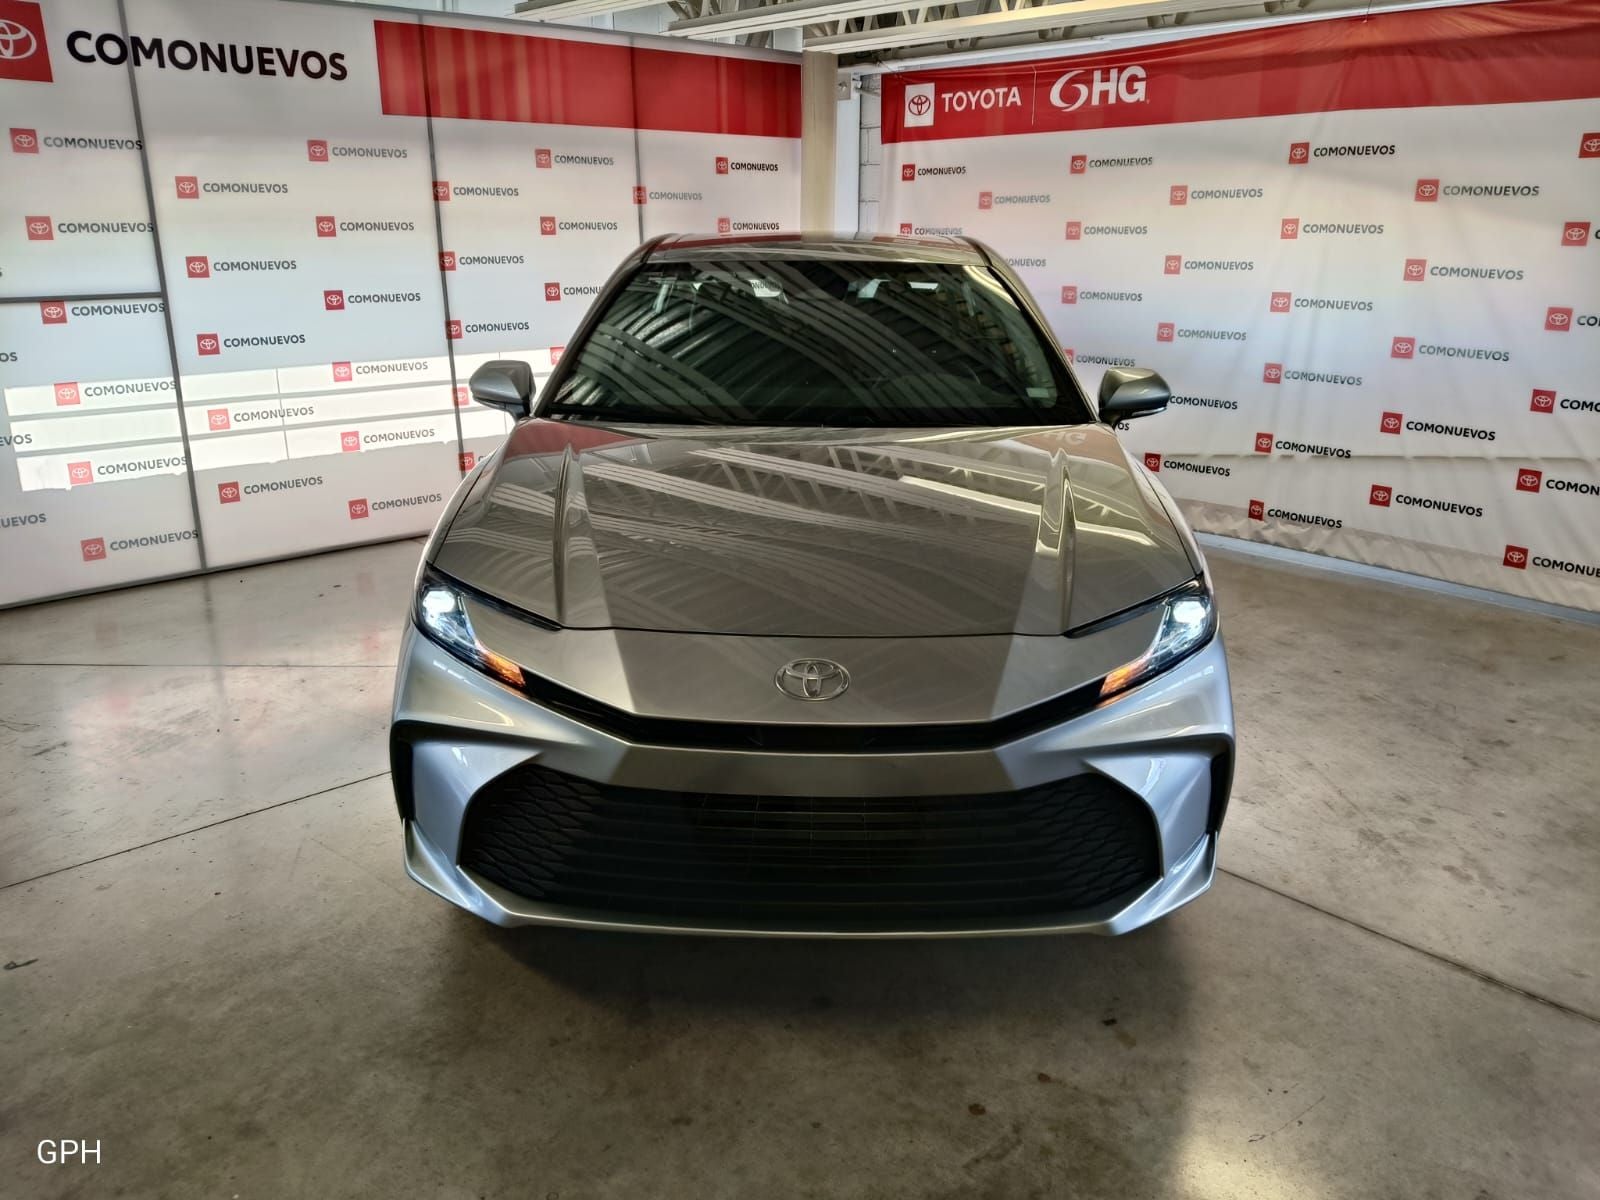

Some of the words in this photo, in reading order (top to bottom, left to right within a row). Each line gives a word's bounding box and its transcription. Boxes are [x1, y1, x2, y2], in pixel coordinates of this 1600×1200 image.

[66, 30, 349, 81] COMONUEVOS
[941, 86, 1022, 113] TOYOTA
[1091, 65, 1147, 106] HG
[43, 136, 143, 151] COMONUEVOS
[332, 146, 408, 159] COMONUEVOS
[1313, 144, 1396, 158] COMONUEVOS
[554, 155, 615, 166] COMONUEVOS
[730, 162, 779, 172] COMONUEVOS
[1089, 156, 1153, 168] COMONUEVOS
[917, 166, 967, 176] COMONUEVOS
[203, 182, 289, 195] COMONUEVOS
[453, 186, 519, 197] COMONUEVOS
[1190, 188, 1263, 200] COMONUEVOS
[1442, 185, 1540, 197] COMONUEVOS
[649, 191, 703, 201] COMONUEVOS
[994, 194, 1051, 205] COMONUEVOS
[58, 221, 155, 234] COMONUEVOS
[339, 221, 415, 232] COMONUEVOS
[558, 221, 618, 231] COMONUEVOS
[732, 222, 780, 231] COMONUEVOS
[1083, 225, 1148, 236] COMONUEVOS
[1302, 223, 1385, 235] COMONUEVOS
[213, 260, 297, 272] COMONUEVOS
[459, 255, 524, 266] COMONUEVOS
[1184, 260, 1254, 271] COMONUEVOS
[1430, 265, 1524, 281] COMONUEVOS
[563, 286, 601, 296] COMONU
[1079, 290, 1143, 302] COMONUEVOS
[347, 292, 421, 305] COMONUEVOS
[1294, 298, 1374, 312] COMONUEVOS
[71, 302, 165, 317] COMONUEVOS
[465, 321, 530, 333] COMONUEVOS
[223, 334, 306, 348] COMONUEVOS
[1177, 328, 1247, 341] COMONUEVOS
[1418, 344, 1510, 362] COMONUEVOS
[1076, 354, 1136, 367] COMONUEVOS
[355, 361, 429, 375] COMONUEVOS
[1284, 370, 1363, 386] COMONUEVOS
[84, 380, 177, 397] COMONUEVOS
[1169, 395, 1238, 410] COMONUEVOS
[233, 406, 315, 423] COMONUEVOS
[363, 428, 436, 444] COMONUEVOS
[1405, 421, 1496, 441] COMONUEVOS
[1275, 440, 1351, 459] COMONUEVOS
[97, 456, 188, 476] COMONUEVOS
[1163, 459, 1231, 477] COMONUEVOS
[243, 476, 324, 495] COMONUEVOS
[1545, 479, 1600, 496] COMON
[371, 493, 443, 511] COMONUEVOS
[1395, 494, 1483, 517] COMONUEVOS
[0, 513, 48, 528] UEVOS
[1267, 508, 1343, 529] COMONUEVOS
[109, 529, 199, 551] COMONUEVOS
[1532, 556, 1600, 578] COMONUE
